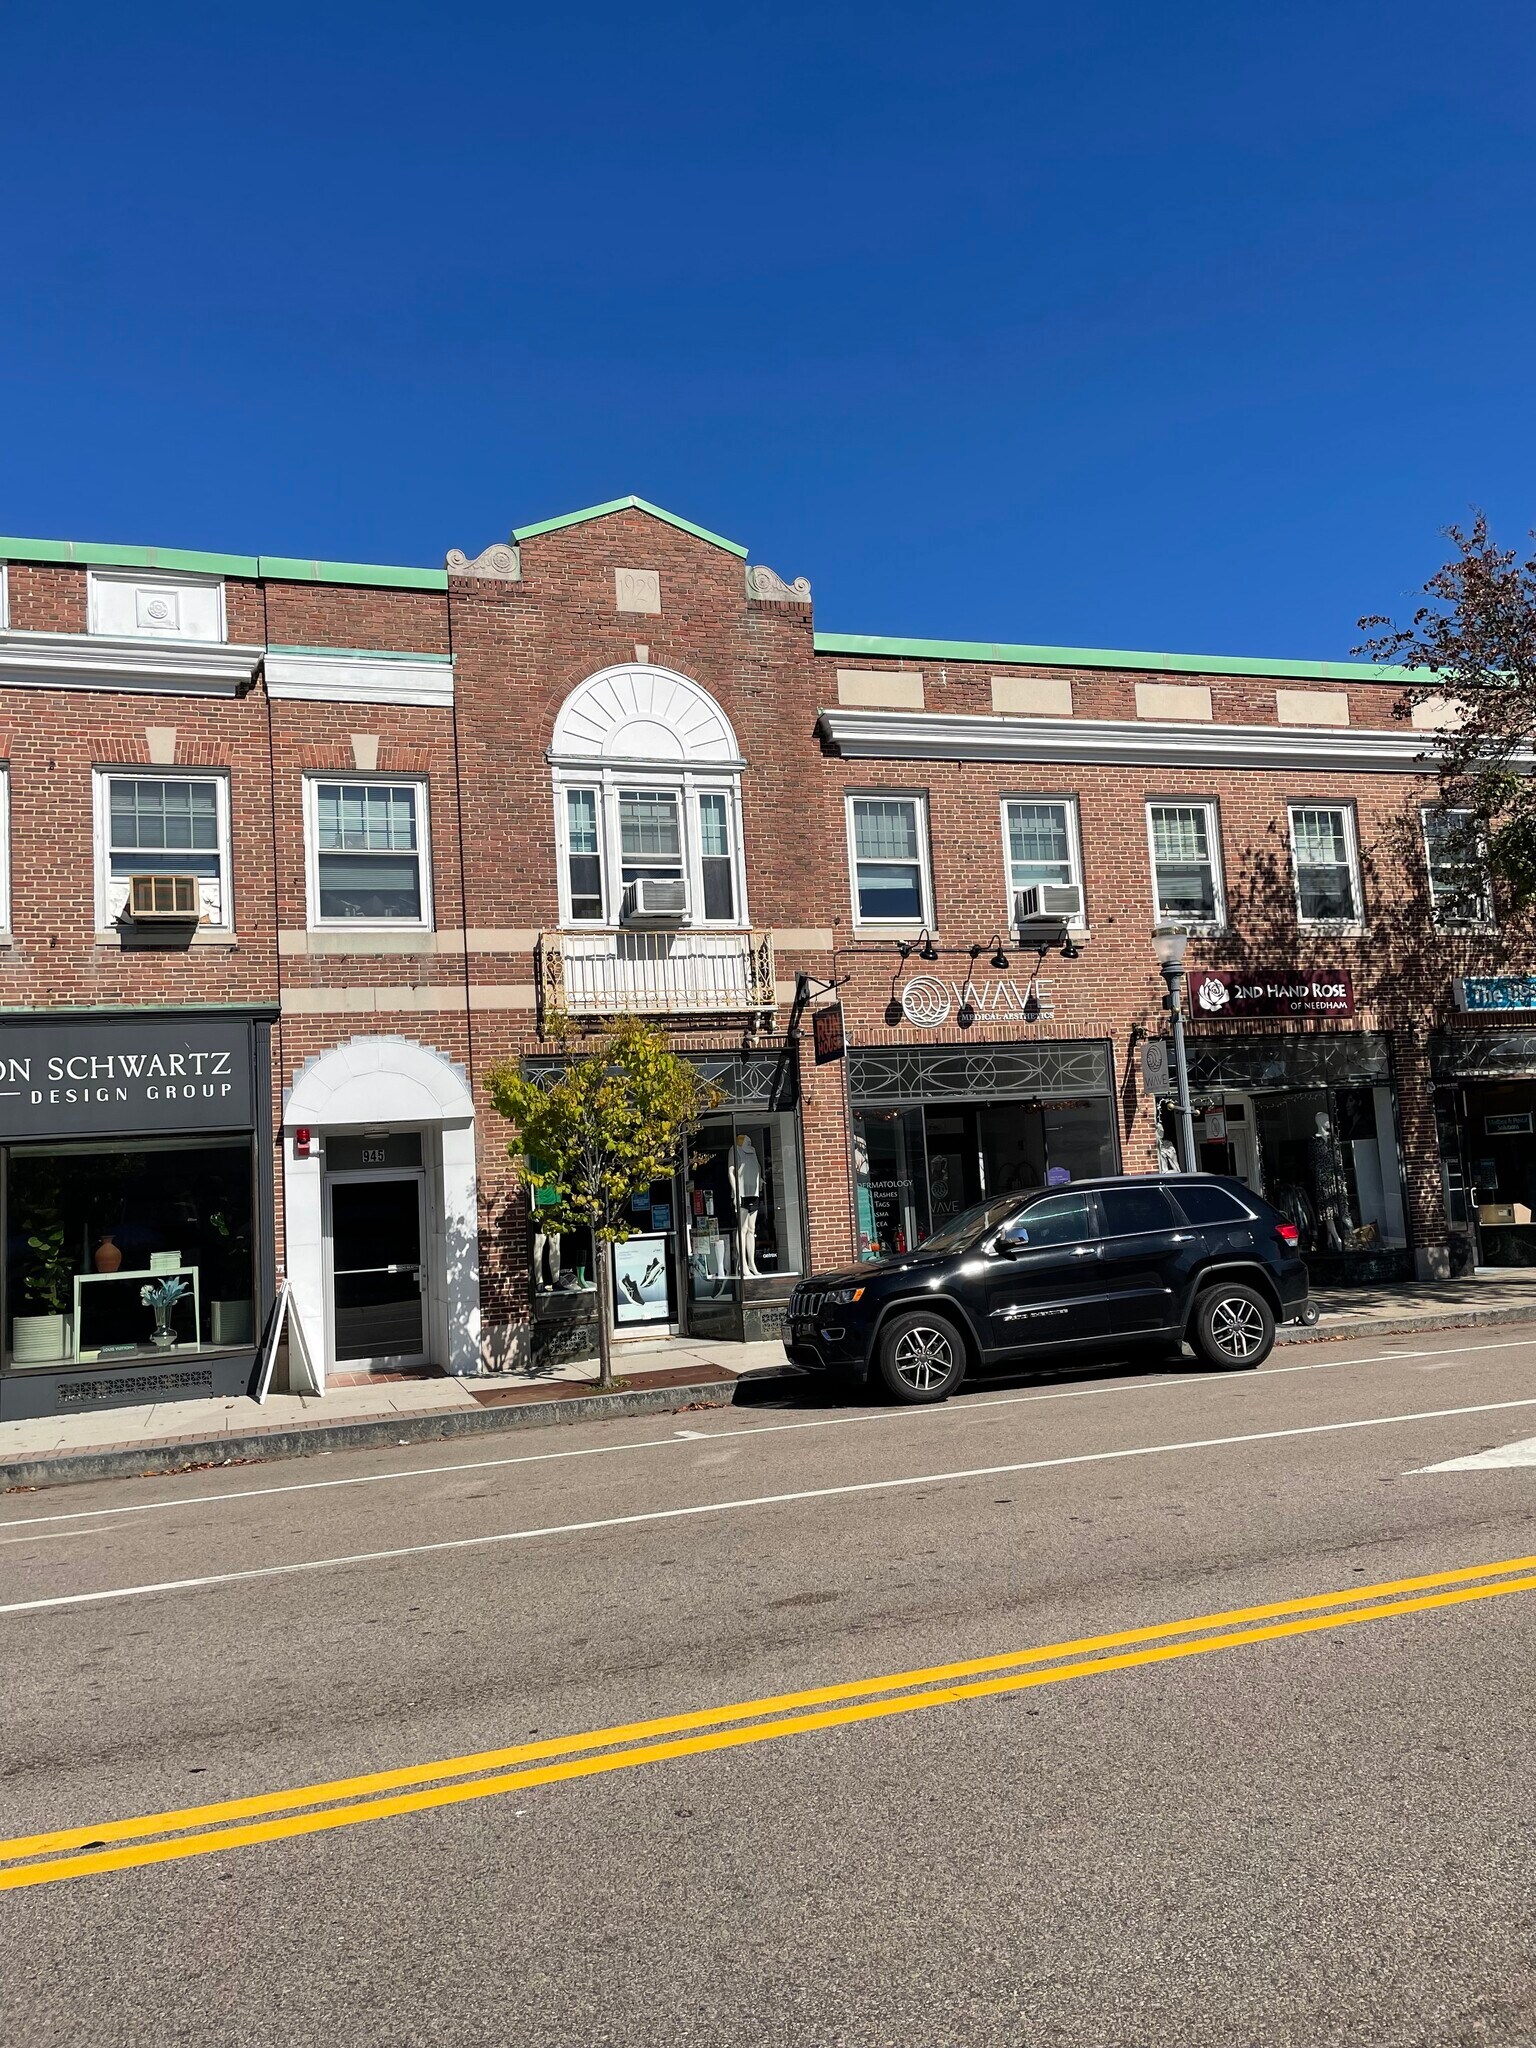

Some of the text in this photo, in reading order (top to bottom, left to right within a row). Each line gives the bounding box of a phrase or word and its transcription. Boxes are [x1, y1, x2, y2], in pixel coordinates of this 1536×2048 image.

[620, 574, 658, 603] 1929
[952, 980, 1055, 1010] WAVE
[1234, 983, 1346, 999] 2ND HAND ROSE
[1472, 985, 1503, 1003] The
[1290, 1001, 1348, 1010] OF NEEDHAM
[961, 1012, 1055, 1021] MEDICAL AESTHETICS
[817, 1012, 841, 1040] RUN
[818, 1036, 843, 1055] HOUSE
[48, 1052, 232, 1081] SCHWARTZ
[1145, 1074, 1168, 1087] WAVE
[31, 1083, 232, 1104] DESIGN GROUP
[363, 1150, 385, 1162] 945
[857, 1180, 913, 1188] DERMATOLOGY
